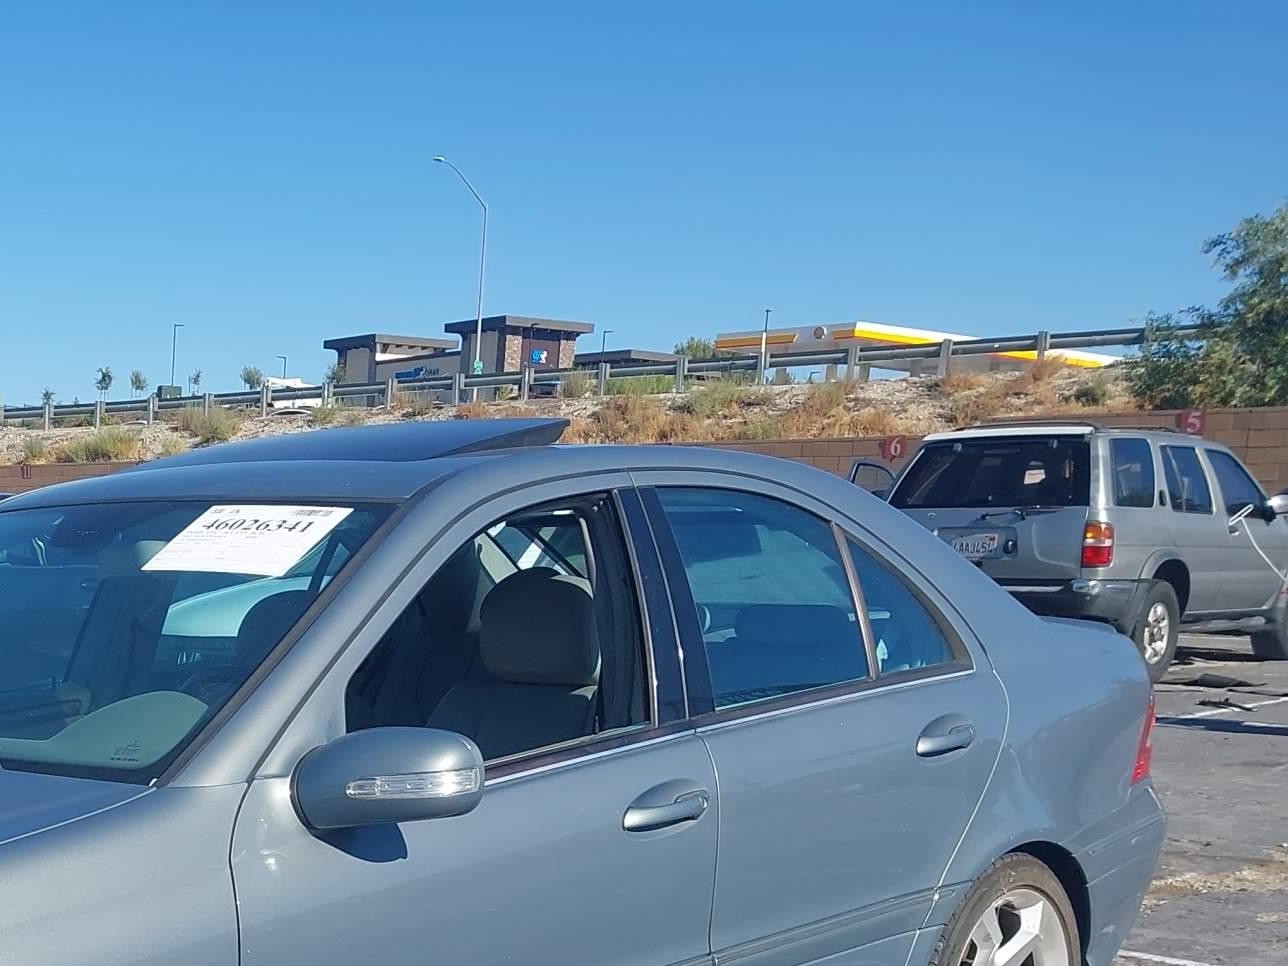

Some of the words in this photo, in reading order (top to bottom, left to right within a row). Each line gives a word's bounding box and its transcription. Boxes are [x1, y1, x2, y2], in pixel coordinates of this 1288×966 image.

[1186, 411, 1201, 432] 5
[890, 436, 901, 456] 6
[201, 518, 314, 533] 46026341
